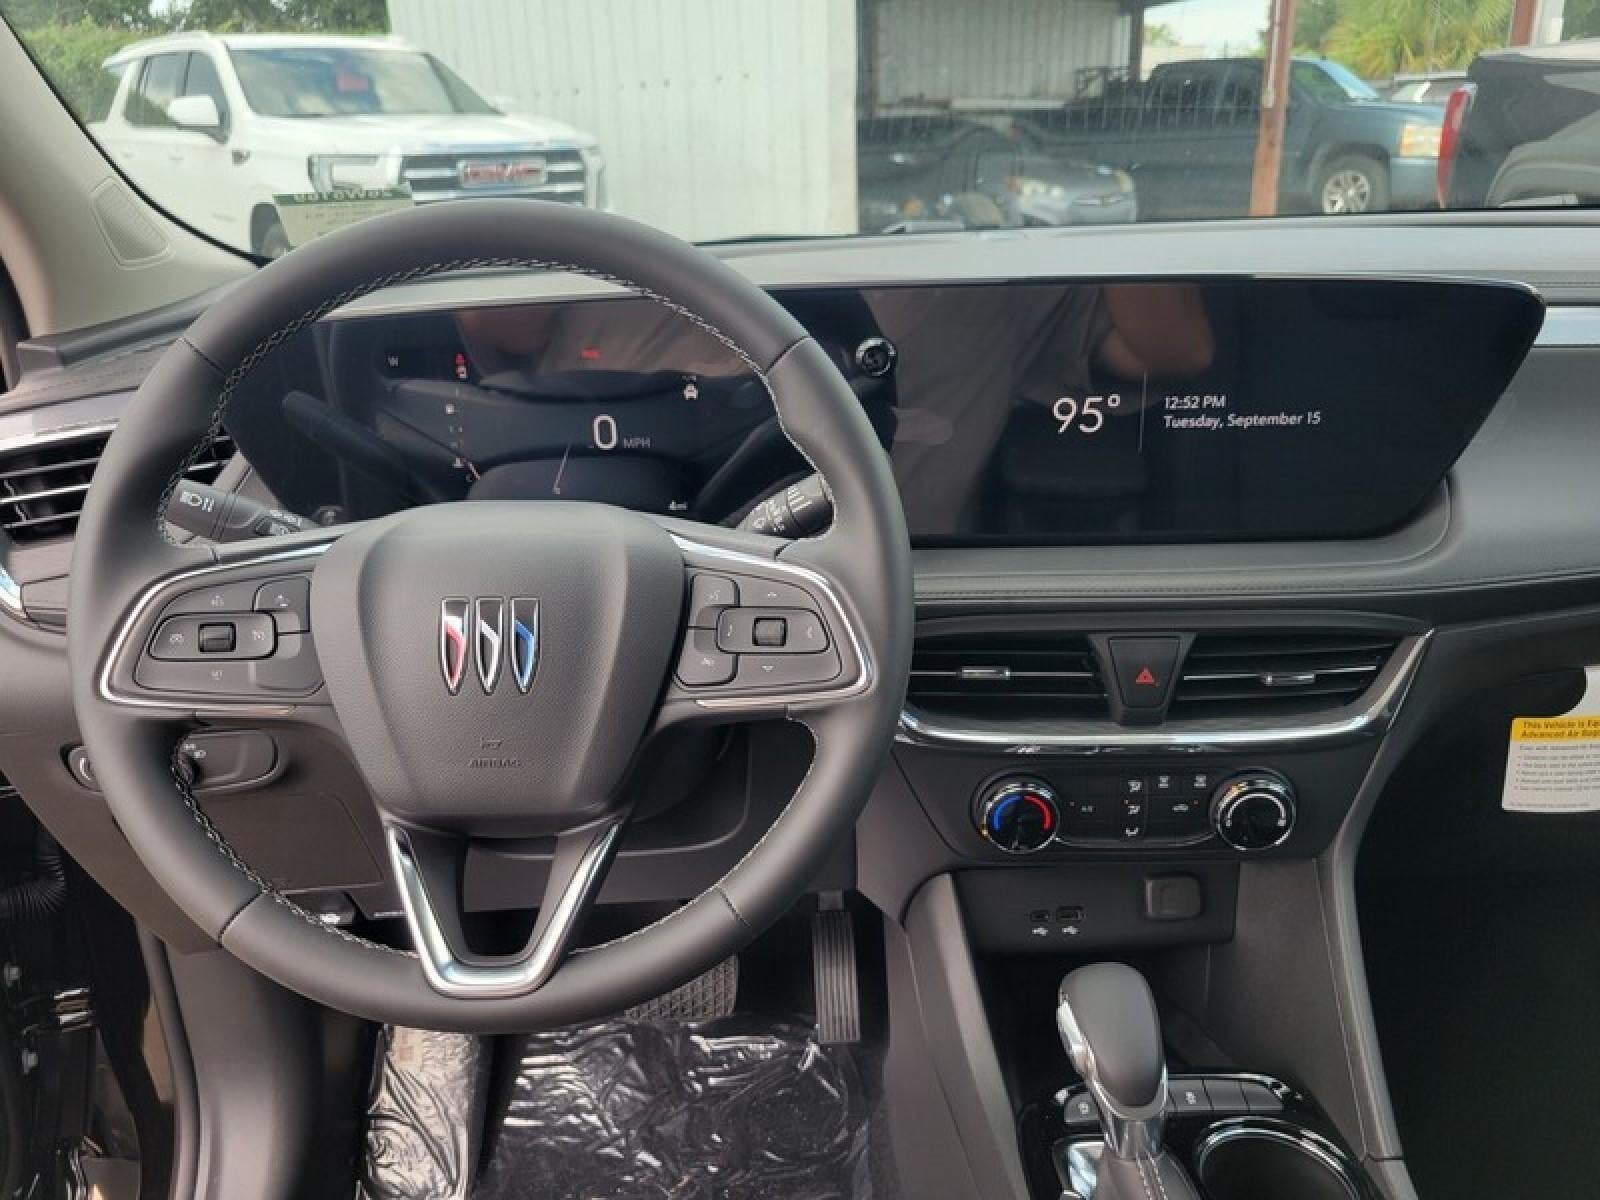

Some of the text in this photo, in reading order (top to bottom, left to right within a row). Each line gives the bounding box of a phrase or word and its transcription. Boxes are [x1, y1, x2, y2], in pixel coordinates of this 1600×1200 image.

[1053, 394, 1121, 434] 95°
[1164, 395, 1226, 410] 12:52 PM
[593, 414, 651, 449] 0 MPH
[1164, 411, 1321, 431] Tuesday, September 15
